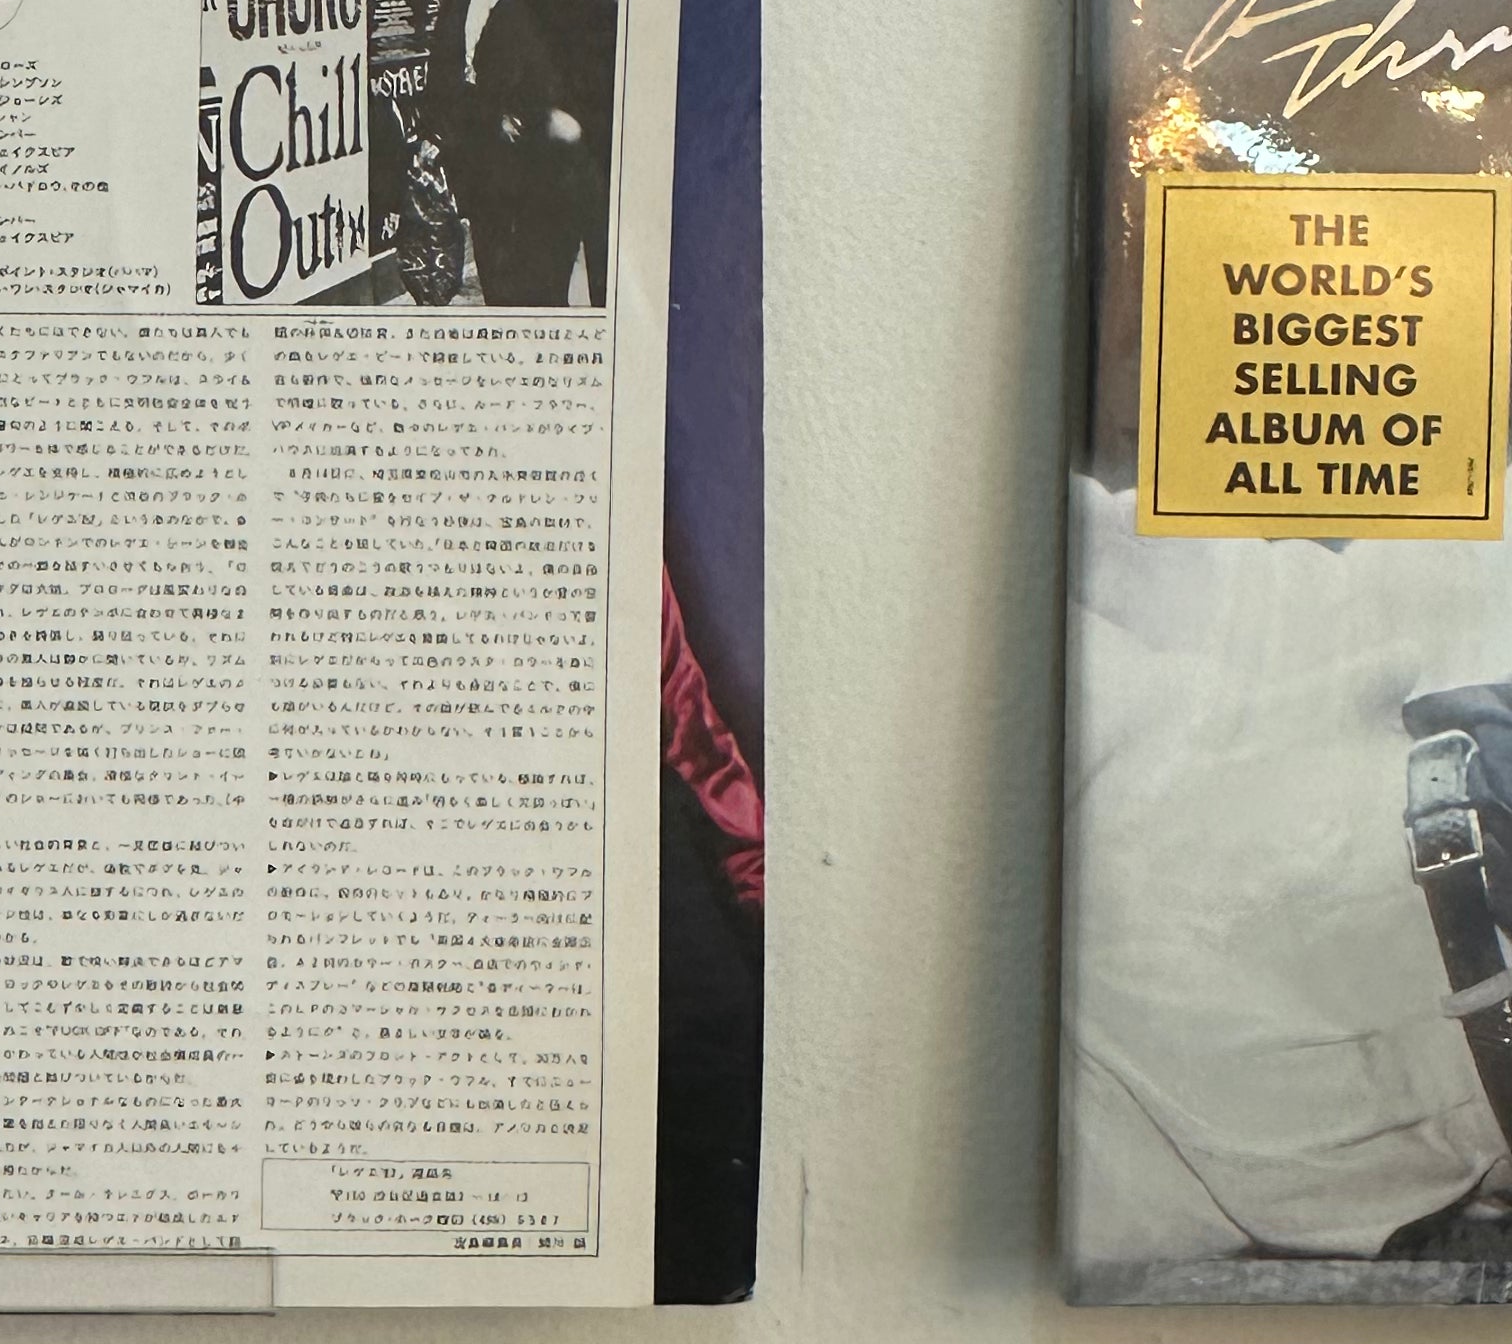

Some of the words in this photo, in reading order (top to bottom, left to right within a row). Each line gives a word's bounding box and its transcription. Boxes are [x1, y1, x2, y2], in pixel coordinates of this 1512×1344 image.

[229, 53, 363, 181] Chill
[1289, 214, 1369, 247] THE
[1222, 262, 1434, 298] WORLD'S
[1233, 312, 1423, 347] BIGGEST
[1234, 361, 1417, 397] SELLING
[1205, 412, 1365, 446] ALBUM
[1382, 413, 1442, 446] OF
[1224, 461, 1302, 495] ALL
[1317, 462, 1419, 496] TIME
